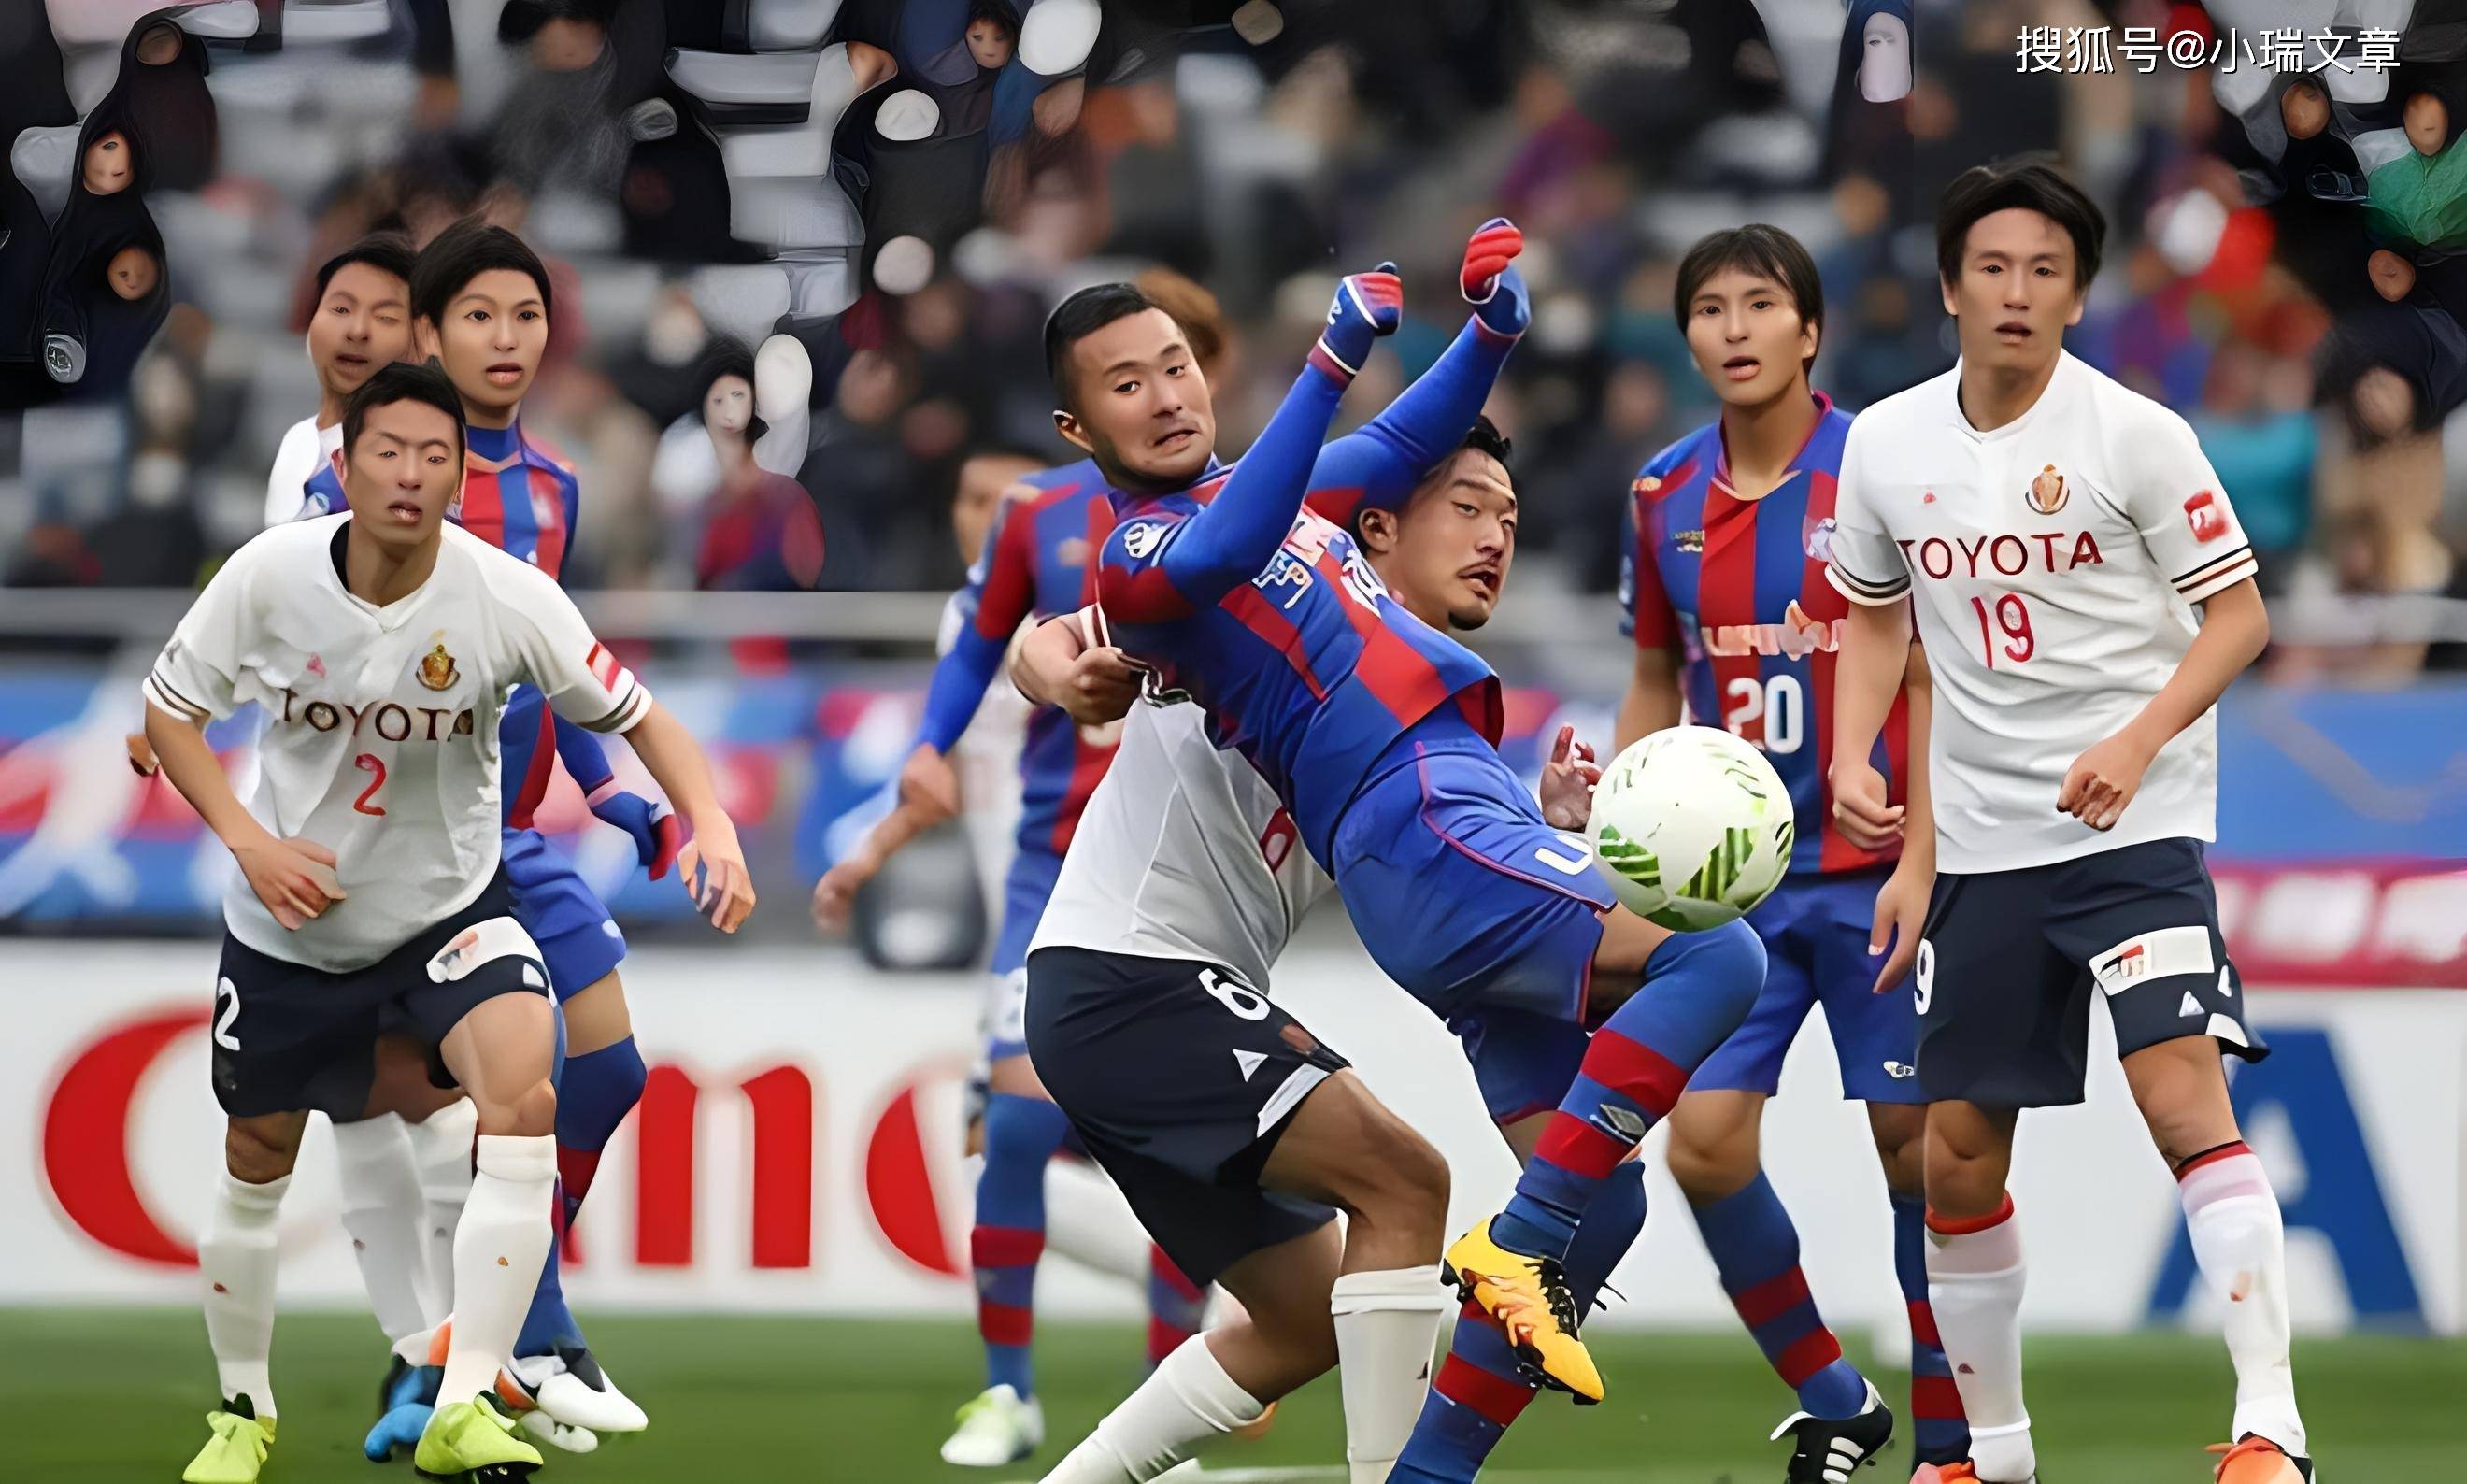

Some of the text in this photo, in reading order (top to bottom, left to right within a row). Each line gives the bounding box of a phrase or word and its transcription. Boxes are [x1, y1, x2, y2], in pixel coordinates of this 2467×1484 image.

[1970, 592, 2034, 669] 19
[1726, 674, 1804, 755] 20
[353, 753, 387, 816] 2
[214, 976, 241, 1051] 2
[1198, 968, 1271, 1021] 6
